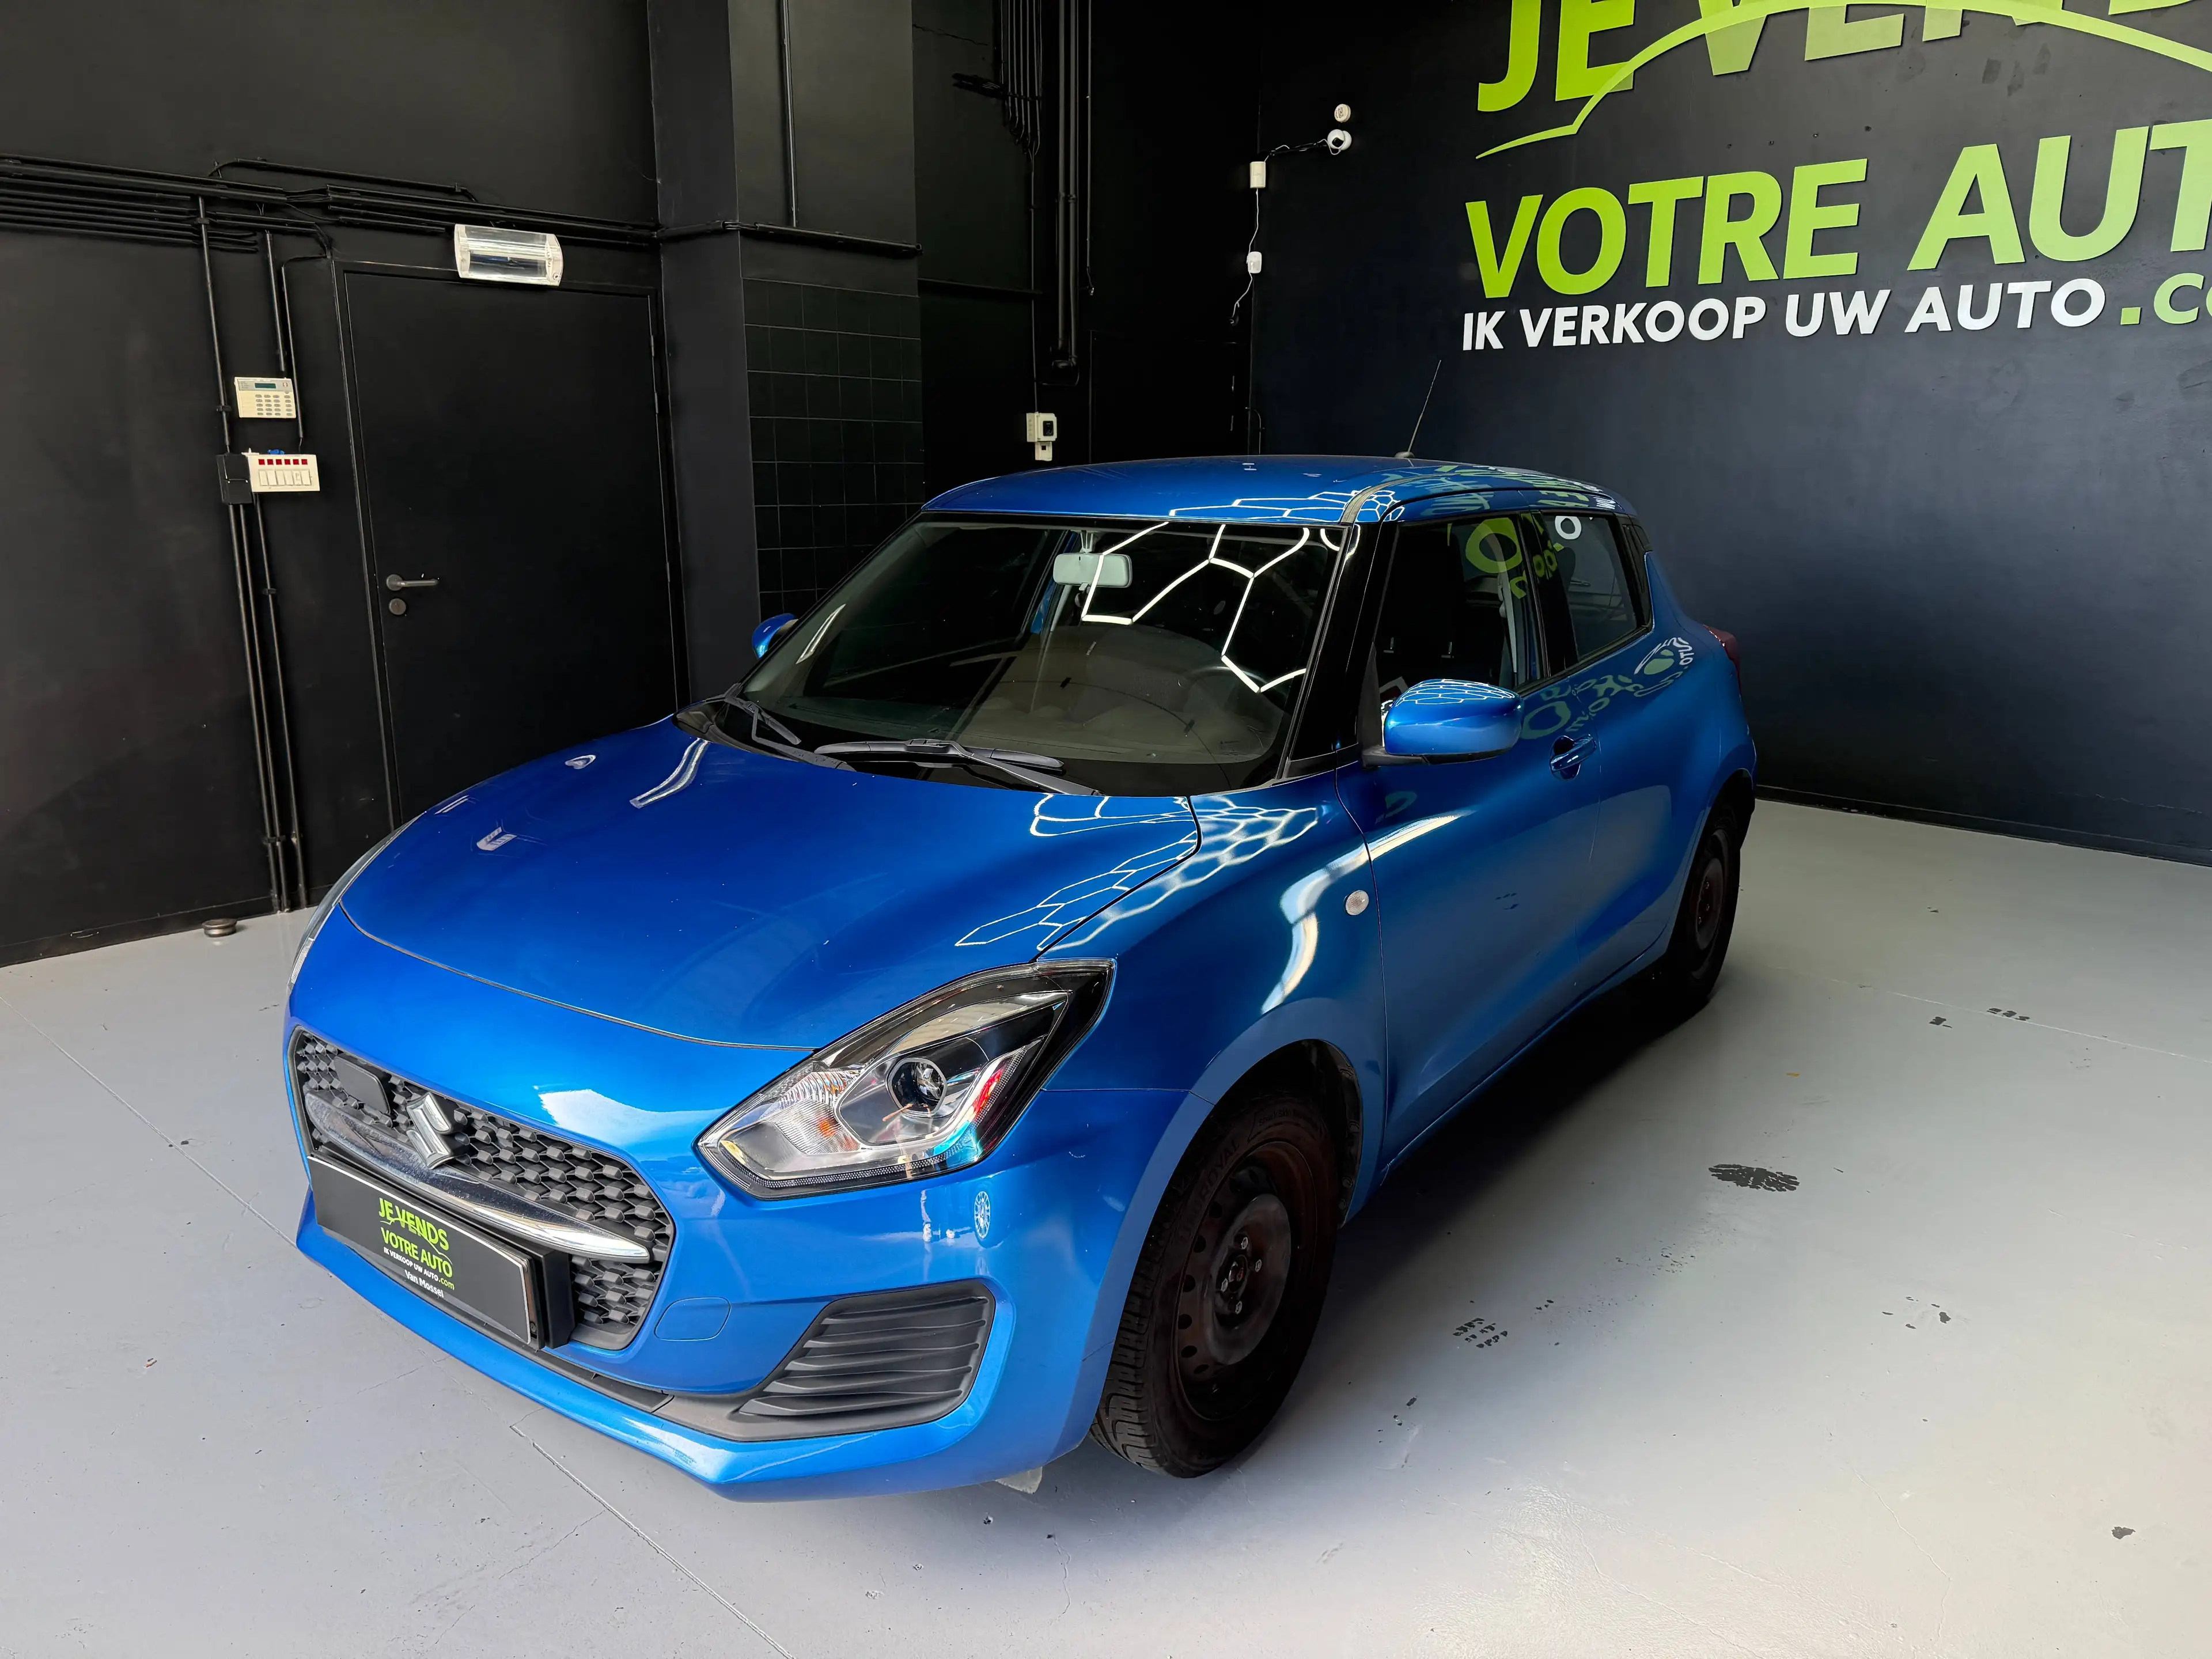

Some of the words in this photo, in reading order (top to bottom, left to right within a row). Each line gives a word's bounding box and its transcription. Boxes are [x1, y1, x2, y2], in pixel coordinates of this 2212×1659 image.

[1465, 158, 1868, 298] VOTRE
[1463, 310, 1506, 350] IK
[1520, 297, 1766, 347] VERKOOP
[1786, 290, 1891, 337] UW
[378, 1197, 393, 1221] JE
[395, 1205, 449, 1251] VENDS
[381, 1226, 419, 1260] VOTRE
[421, 1249, 453, 1278] AUTO
[384, 1247, 389, 1255] IK
[389, 1249, 414, 1267] VERKOOP
[414, 1263, 423, 1273] UW
[404, 1269, 419, 1285] Van
[419, 1277, 444, 1298] Mossel
